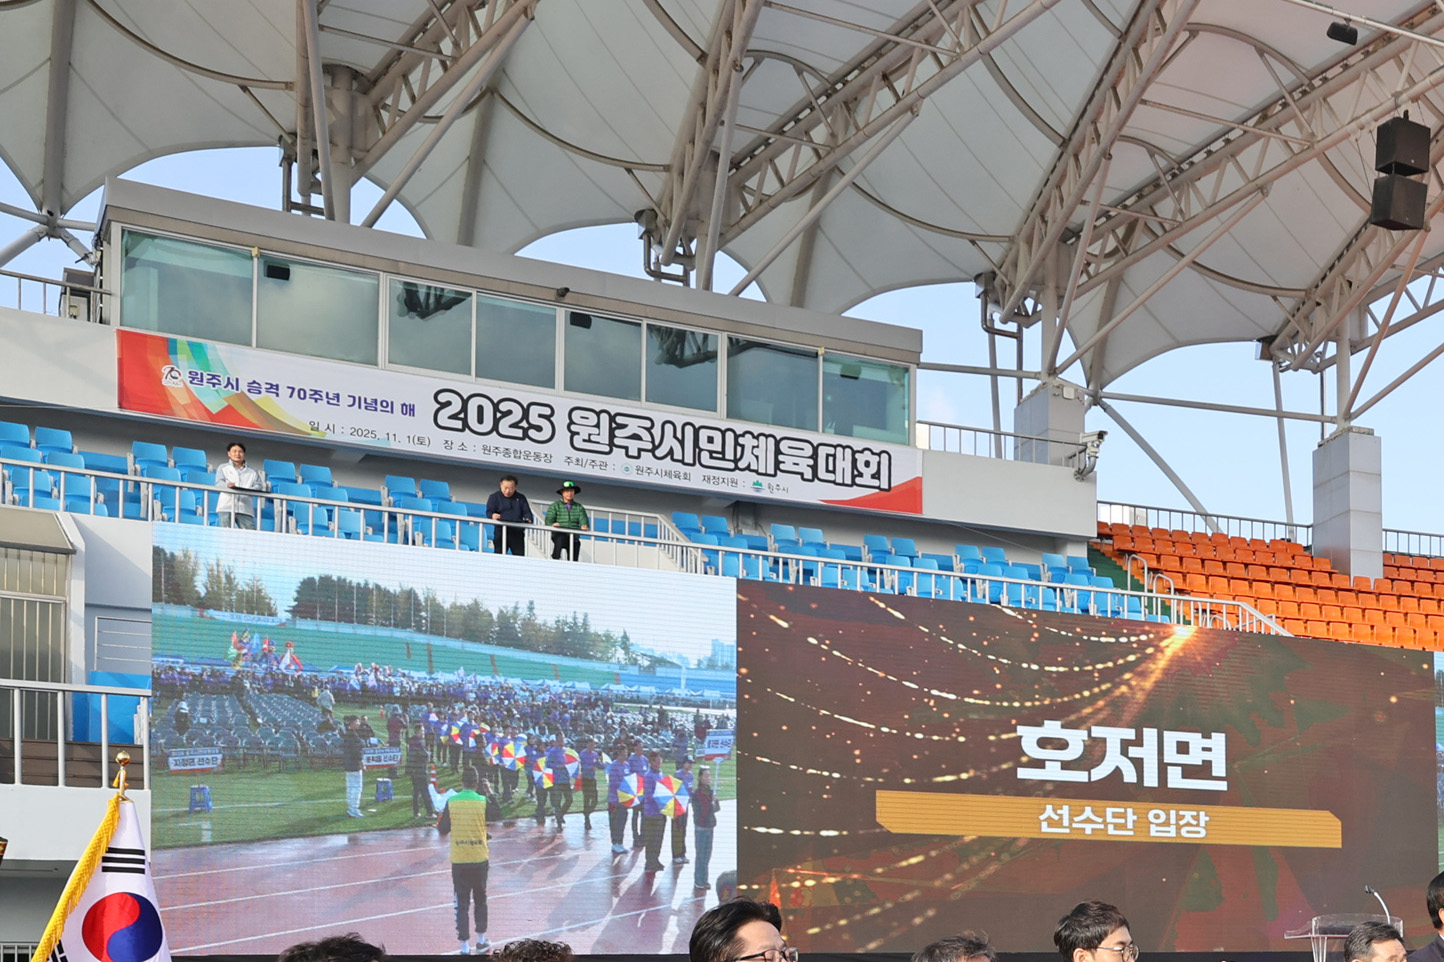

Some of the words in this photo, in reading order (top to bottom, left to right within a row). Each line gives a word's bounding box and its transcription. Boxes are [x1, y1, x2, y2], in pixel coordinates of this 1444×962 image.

[188, 370, 240, 392] 원주시
[247, 380, 280, 398] 승격
[286, 386, 341, 407] 70주년
[347, 394, 395, 415] 기념의
[400, 402, 416, 418] 해
[350, 427, 381, 441] 2025.
[407, 435, 431, 447] 1(토)
[481, 443, 553, 464] 원주종합운동장
[564, 456, 608, 471] 주최/주관
[635, 465, 692, 482] 원주시체육회
[702, 473, 739, 487] 재정지원
[767, 482, 789, 494] 원주시
[433, 388, 556, 444] 2025
[567, 406, 892, 492] 원주시민체육대회
[1016, 719, 1229, 792] 호저면
[1038, 804, 1138, 836] 선수단
[1147, 809, 1210, 839] 입장
